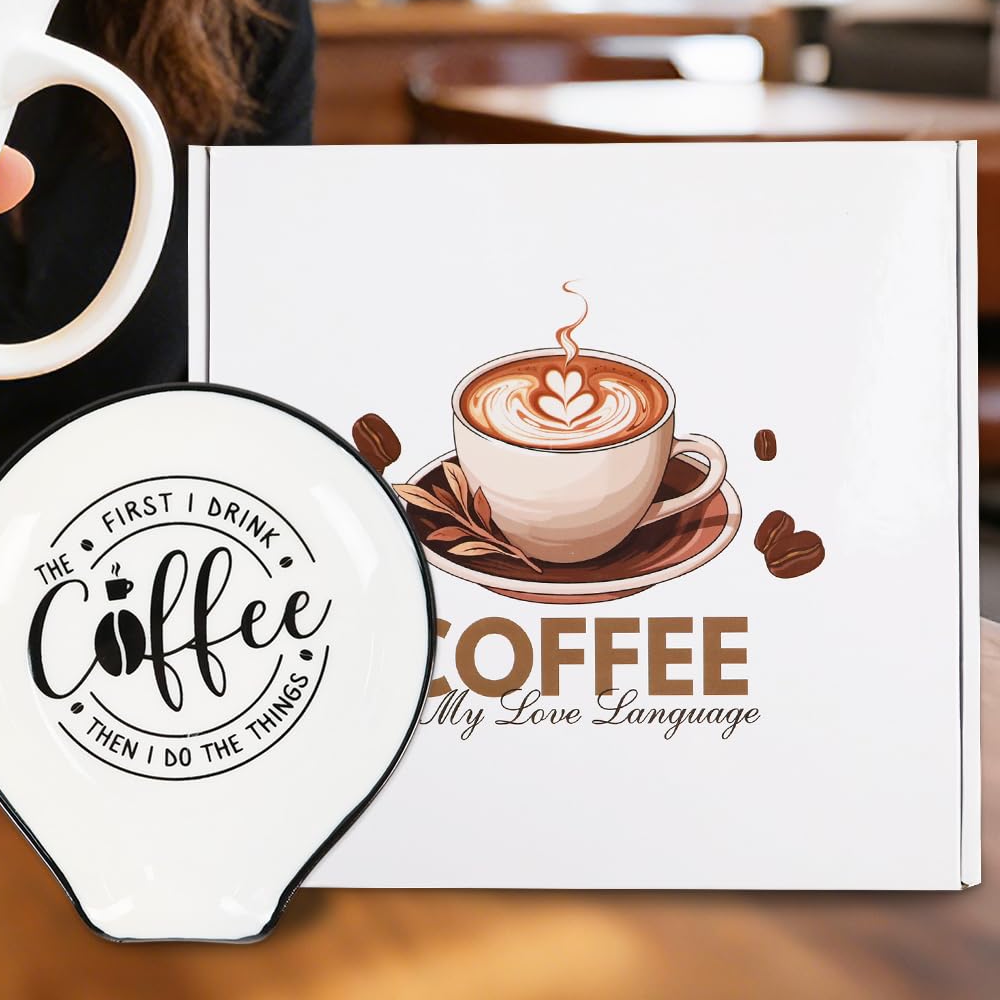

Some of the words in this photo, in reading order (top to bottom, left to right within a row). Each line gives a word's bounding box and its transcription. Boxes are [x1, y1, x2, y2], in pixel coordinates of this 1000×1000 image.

[101, 492, 173, 533] FIRST
[187, 492, 194, 513] I
[207, 496, 281, 549] DRINK
[33, 553, 74, 584] THE
[27, 546, 332, 712] Coffee
[85, 716, 139, 760] THEN
[147, 745, 154, 764] I
[165, 747, 192, 767] DO
[200, 734, 243, 762] THE
[245, 673, 309, 740] THINGS
[419, 688, 485, 741] My
[494, 687, 582, 725] Love
[591, 687, 762, 741] Language
